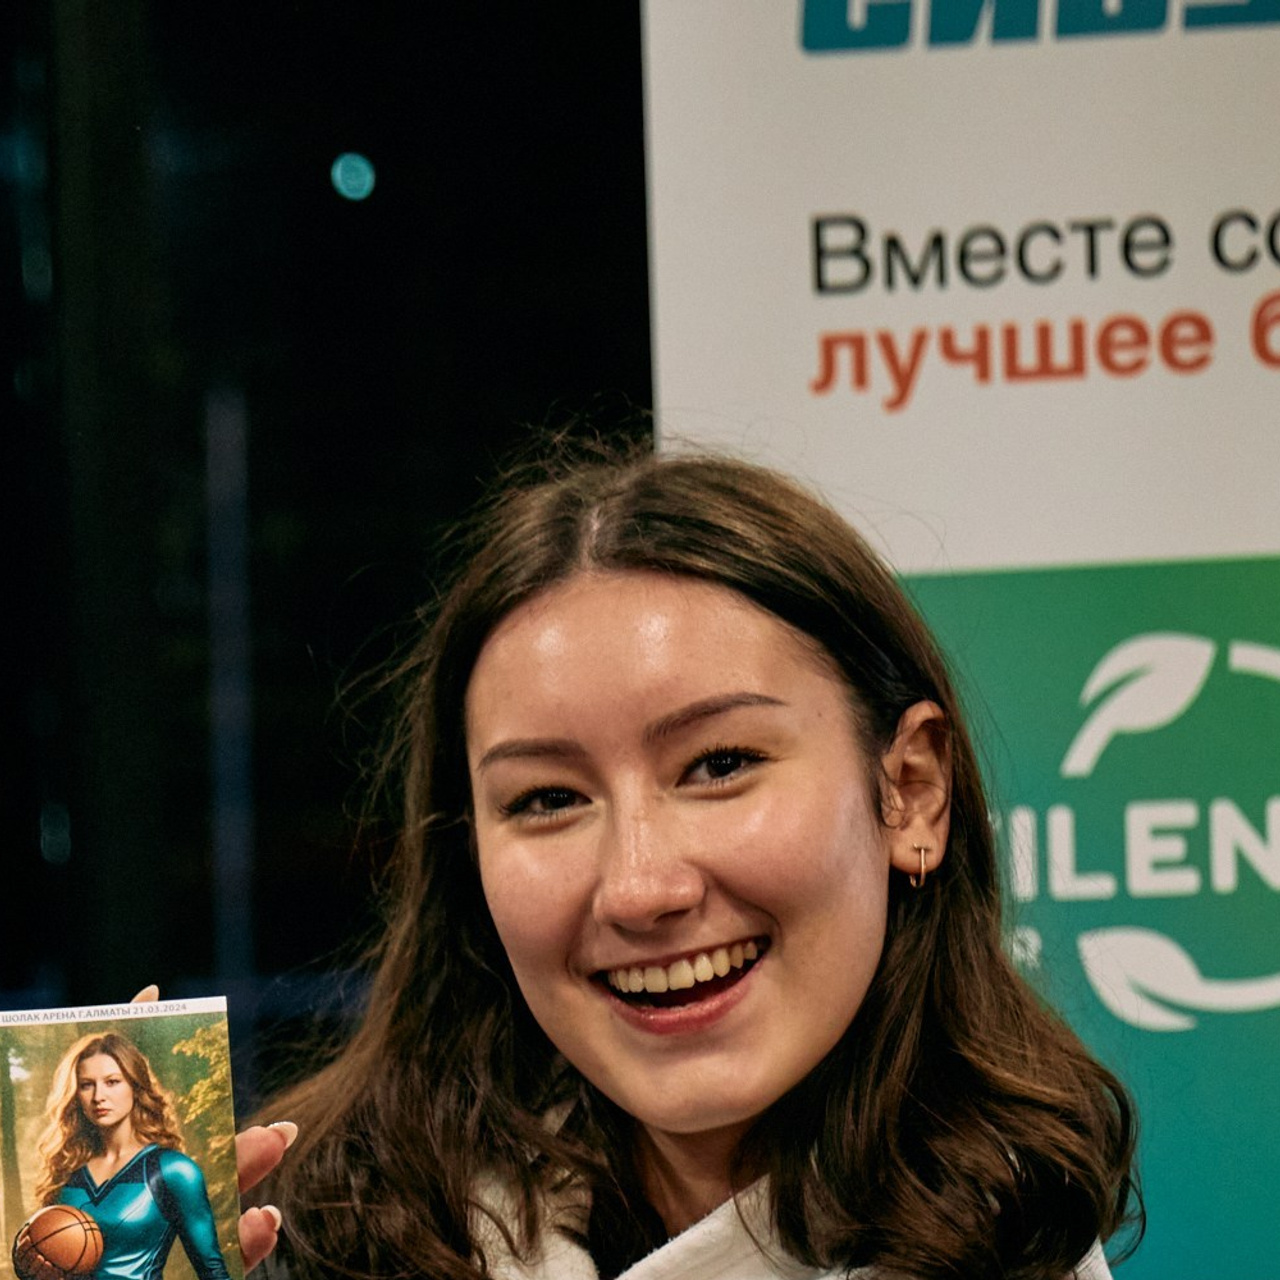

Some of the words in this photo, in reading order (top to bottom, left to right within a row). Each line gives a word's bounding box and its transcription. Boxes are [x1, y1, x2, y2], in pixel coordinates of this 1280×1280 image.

[809, 211, 1174, 297] Вместе
[1208, 207, 1280, 276] с
[809, 307, 1216, 414] лучшее
[988, 794, 1280, 901] ILEN
[43, 1010, 76, 1021] АРЕНА
[133, 1003, 187, 1016] 21.03.2024
